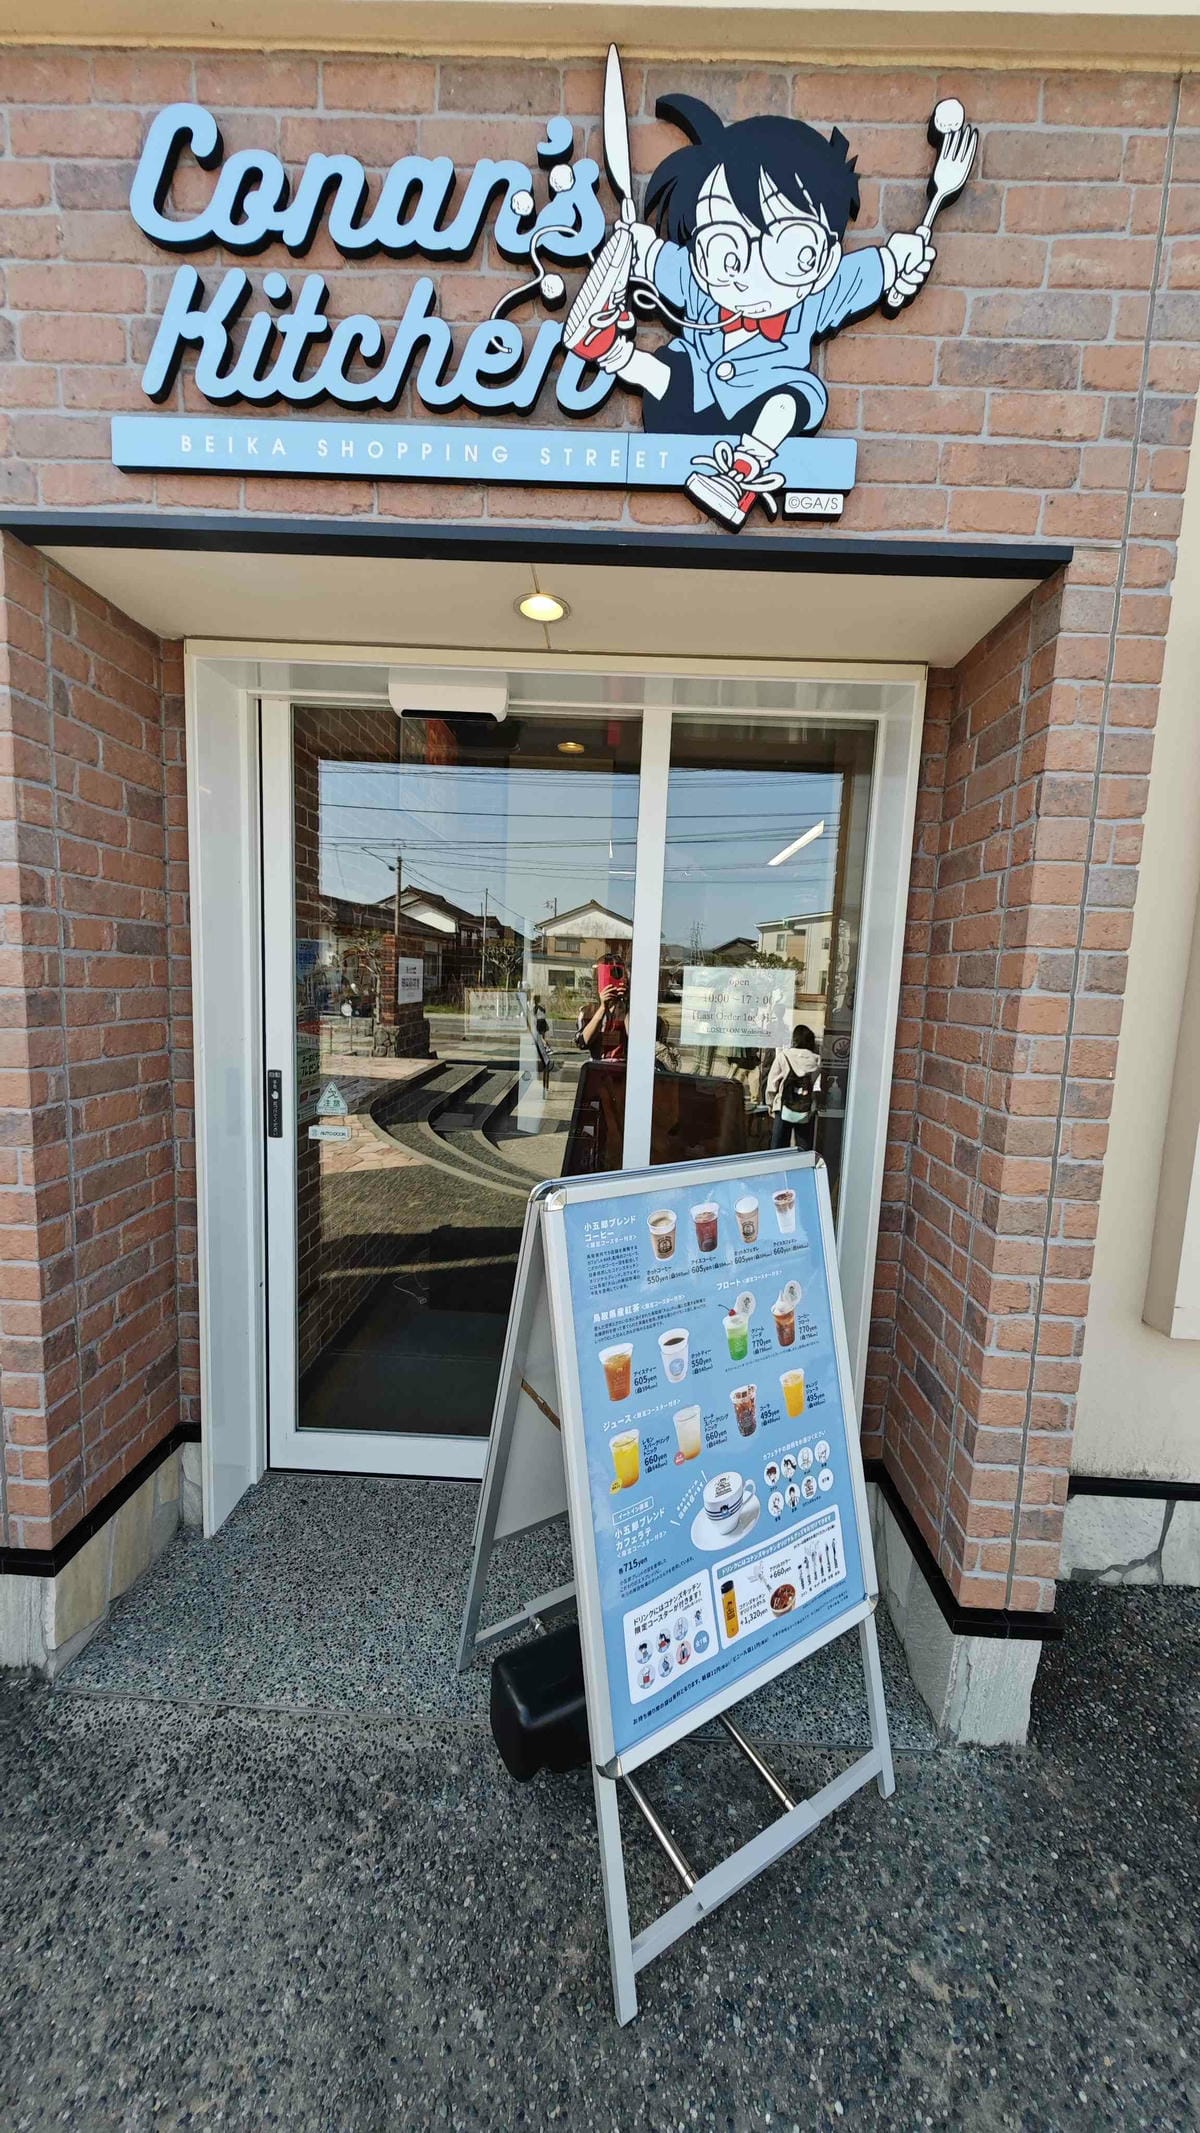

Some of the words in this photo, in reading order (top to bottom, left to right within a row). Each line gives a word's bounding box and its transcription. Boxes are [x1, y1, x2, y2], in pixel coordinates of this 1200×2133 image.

[128, 102, 607, 262] Conan's
[140, 264, 618, 412] Kitchen
[181, 433, 288, 456] BEIKA
[316, 438, 510, 464] SHOPPING
[540, 447, 670, 470] STREET
[729, 979, 750, 988] open
[584, 1229, 614, 1242] コーヒー
[716, 1277, 740, 1291] フロート
[602, 1413, 632, 1432] ジュース
[615, 1526, 651, 1551] カフェラテ
